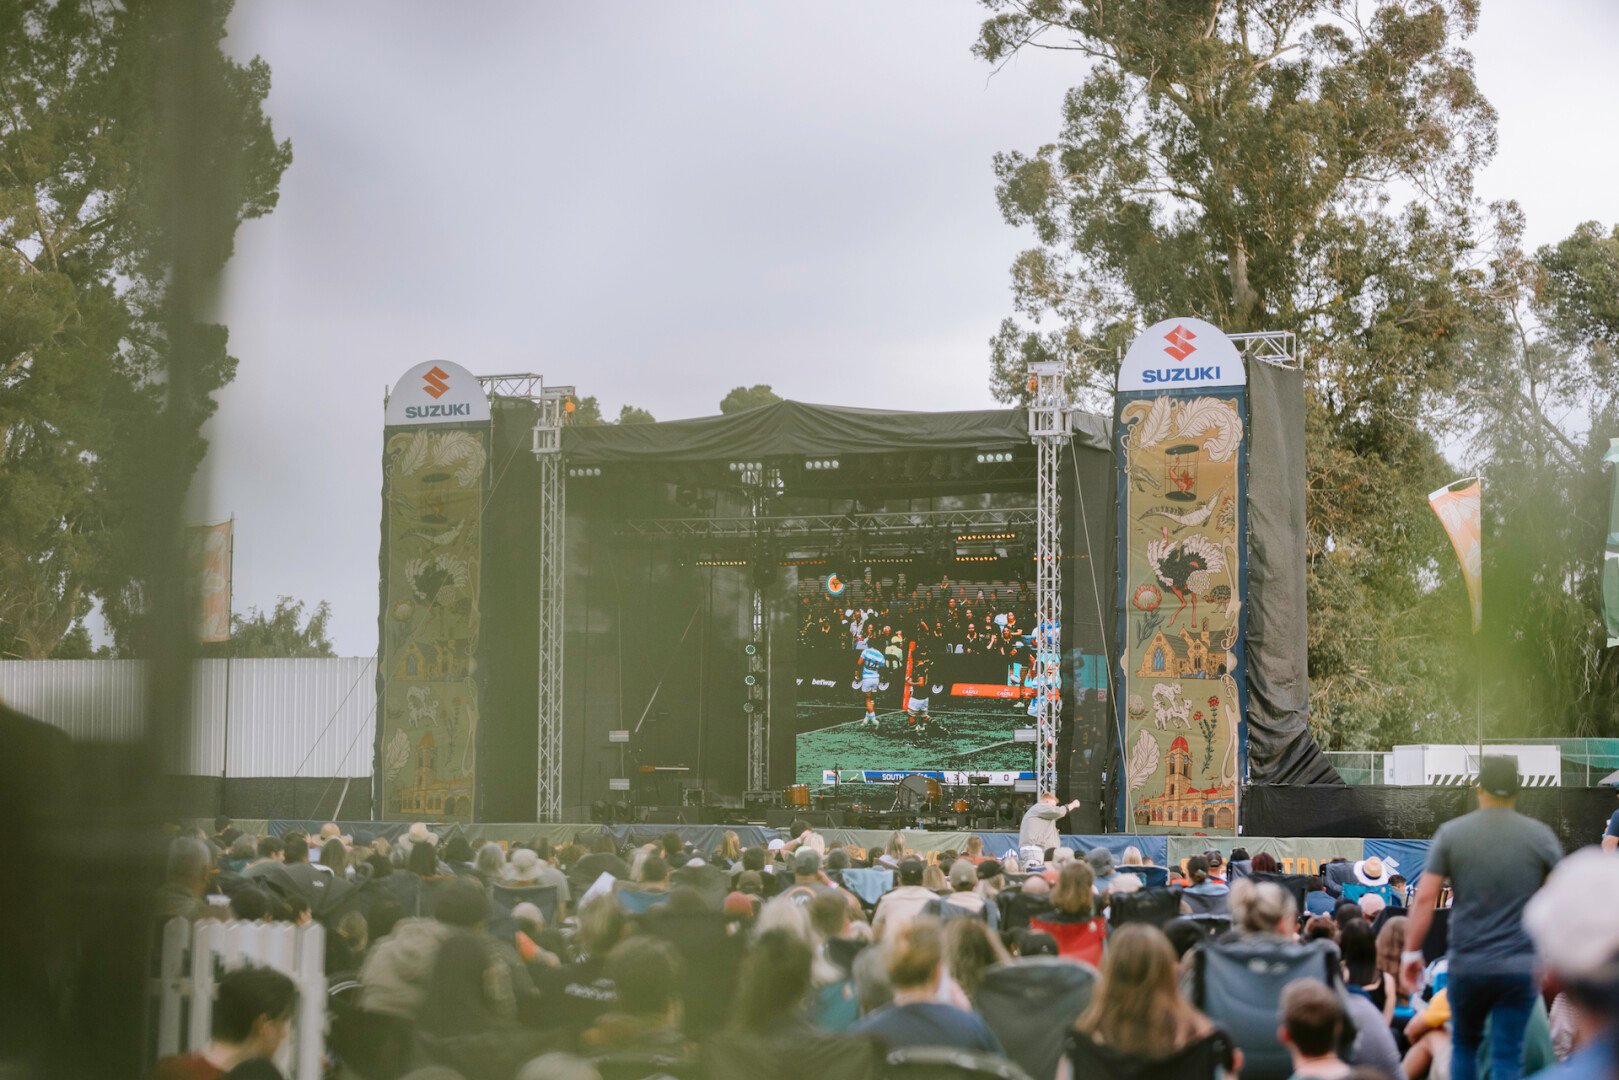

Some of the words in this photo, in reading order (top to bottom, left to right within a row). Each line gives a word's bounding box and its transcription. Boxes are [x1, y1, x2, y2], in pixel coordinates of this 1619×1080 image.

[1142, 366, 1221, 383] SUZUKI
[405, 403, 470, 419] SUZUKI
[811, 678, 837, 688] betway
[882, 773, 904, 781] SOUTH
